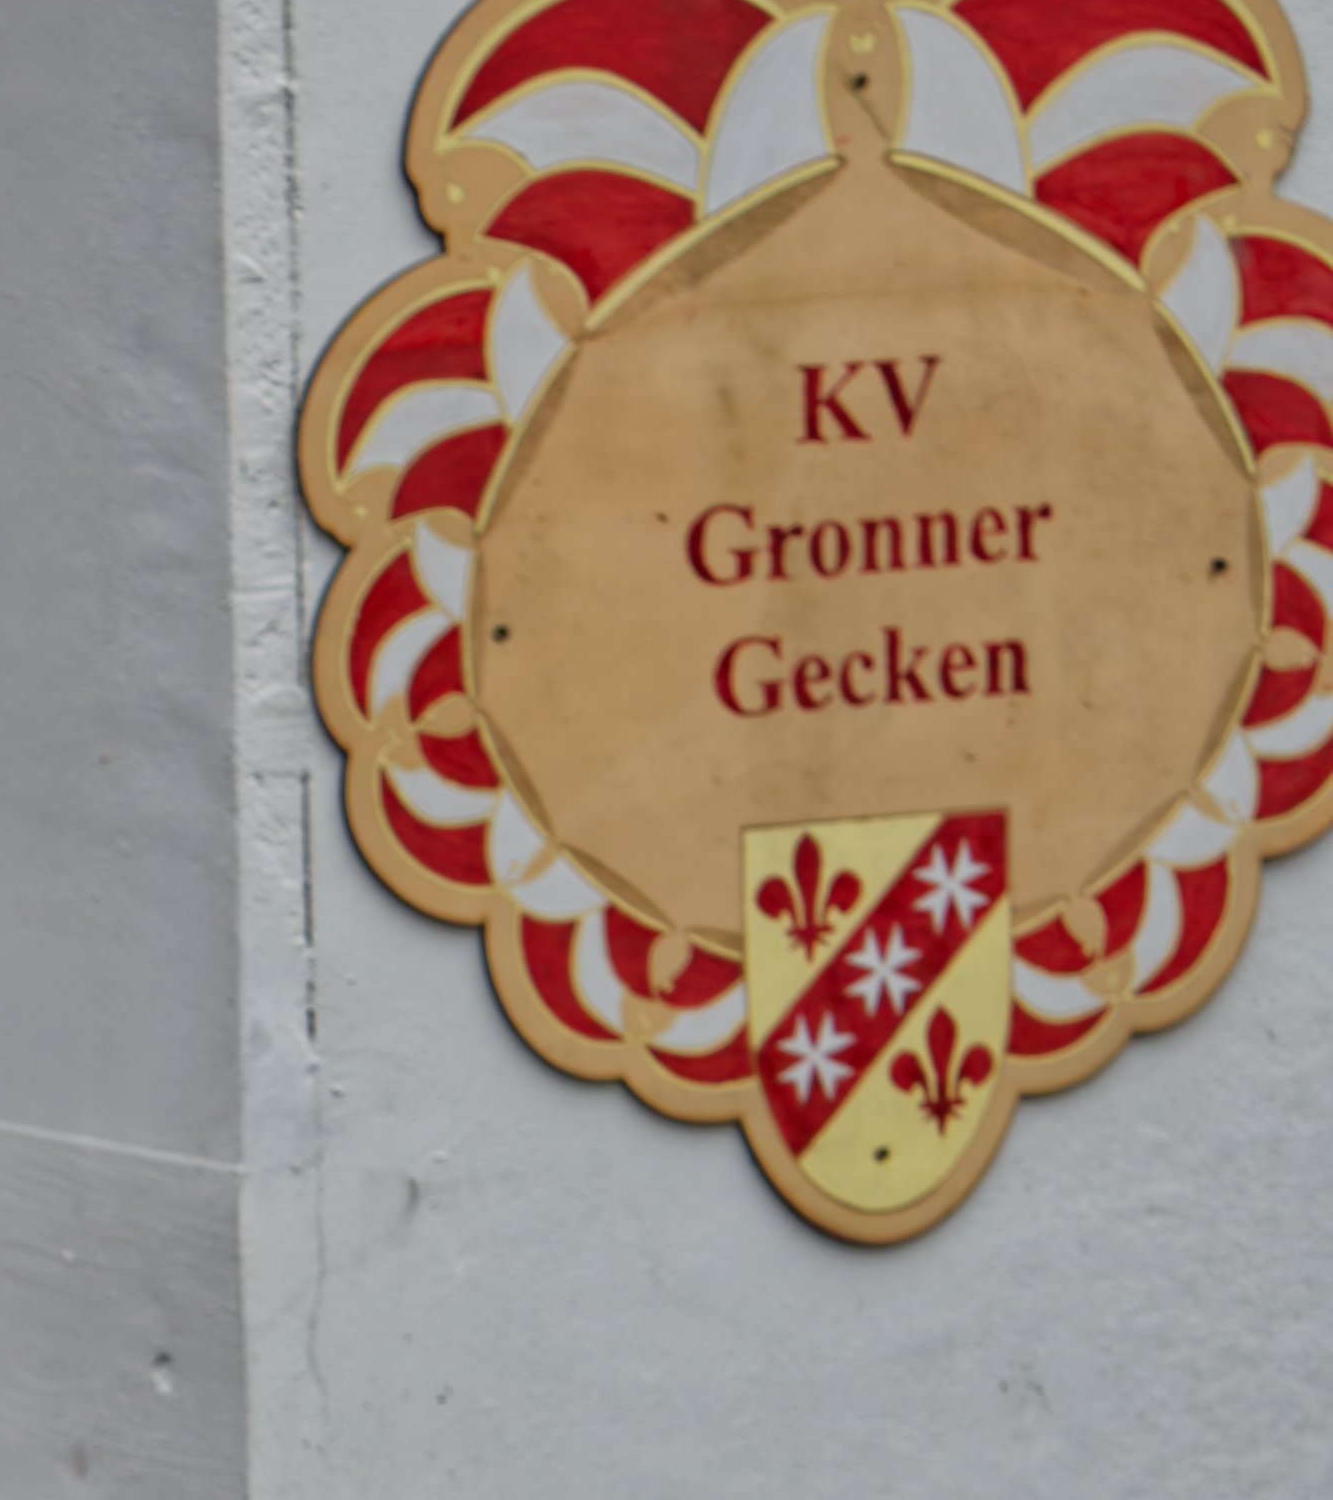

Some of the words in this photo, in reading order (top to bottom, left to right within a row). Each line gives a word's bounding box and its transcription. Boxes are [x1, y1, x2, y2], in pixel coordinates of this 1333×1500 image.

[794, 354, 943, 445] KV
[685, 502, 1055, 587] Gronner
[713, 624, 1031, 718] Gecken
